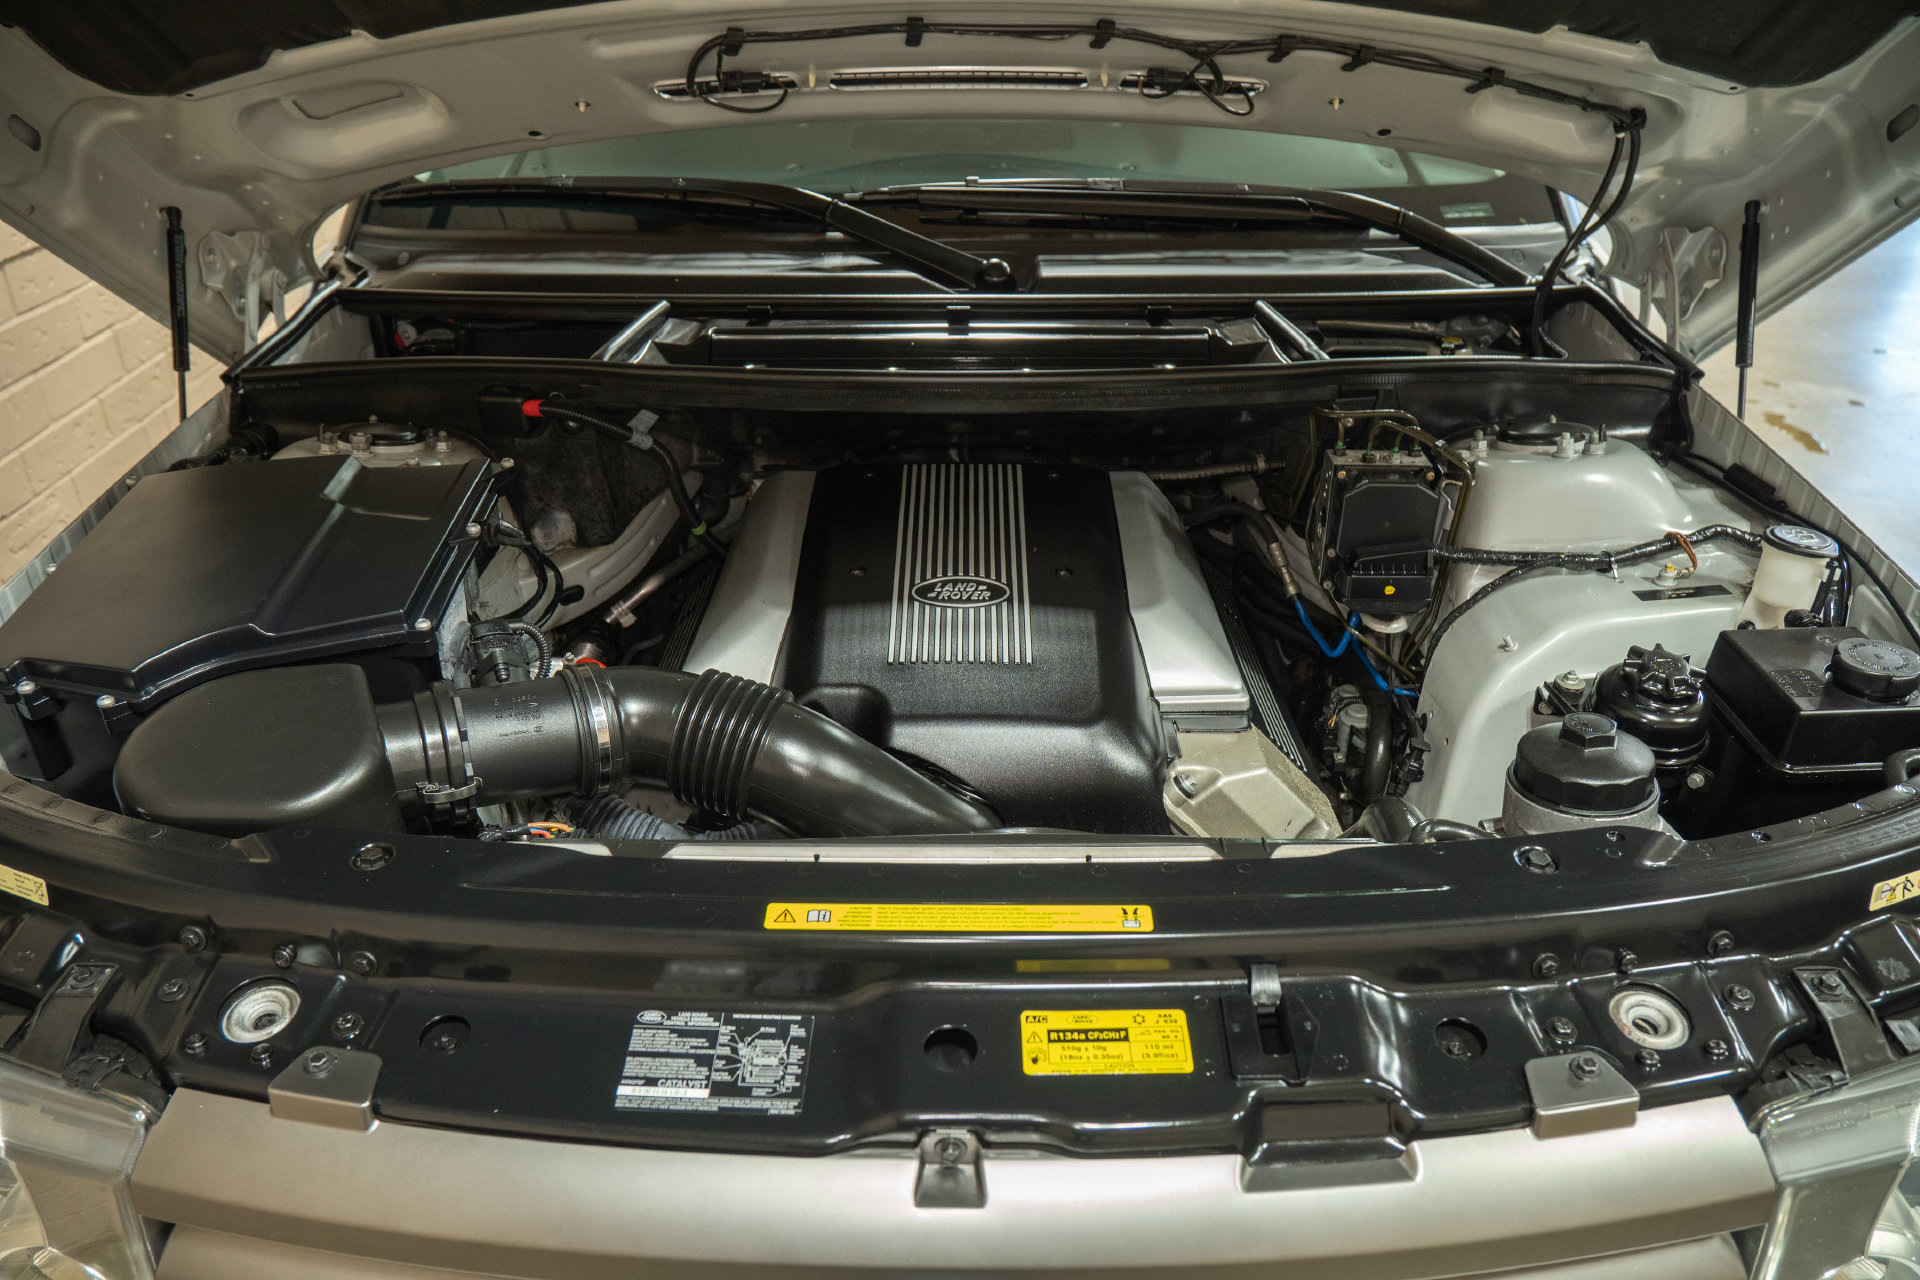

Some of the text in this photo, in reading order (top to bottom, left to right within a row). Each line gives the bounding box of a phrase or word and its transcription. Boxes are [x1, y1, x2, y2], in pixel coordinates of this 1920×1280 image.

[934, 582, 977, 592] LAND
[938, 591, 992, 600] ROVER
[1026, 1015, 1047, 1024] A/C
[1049, 1030, 1086, 1041] R134a
[657, 1078, 708, 1089] CATALYST
